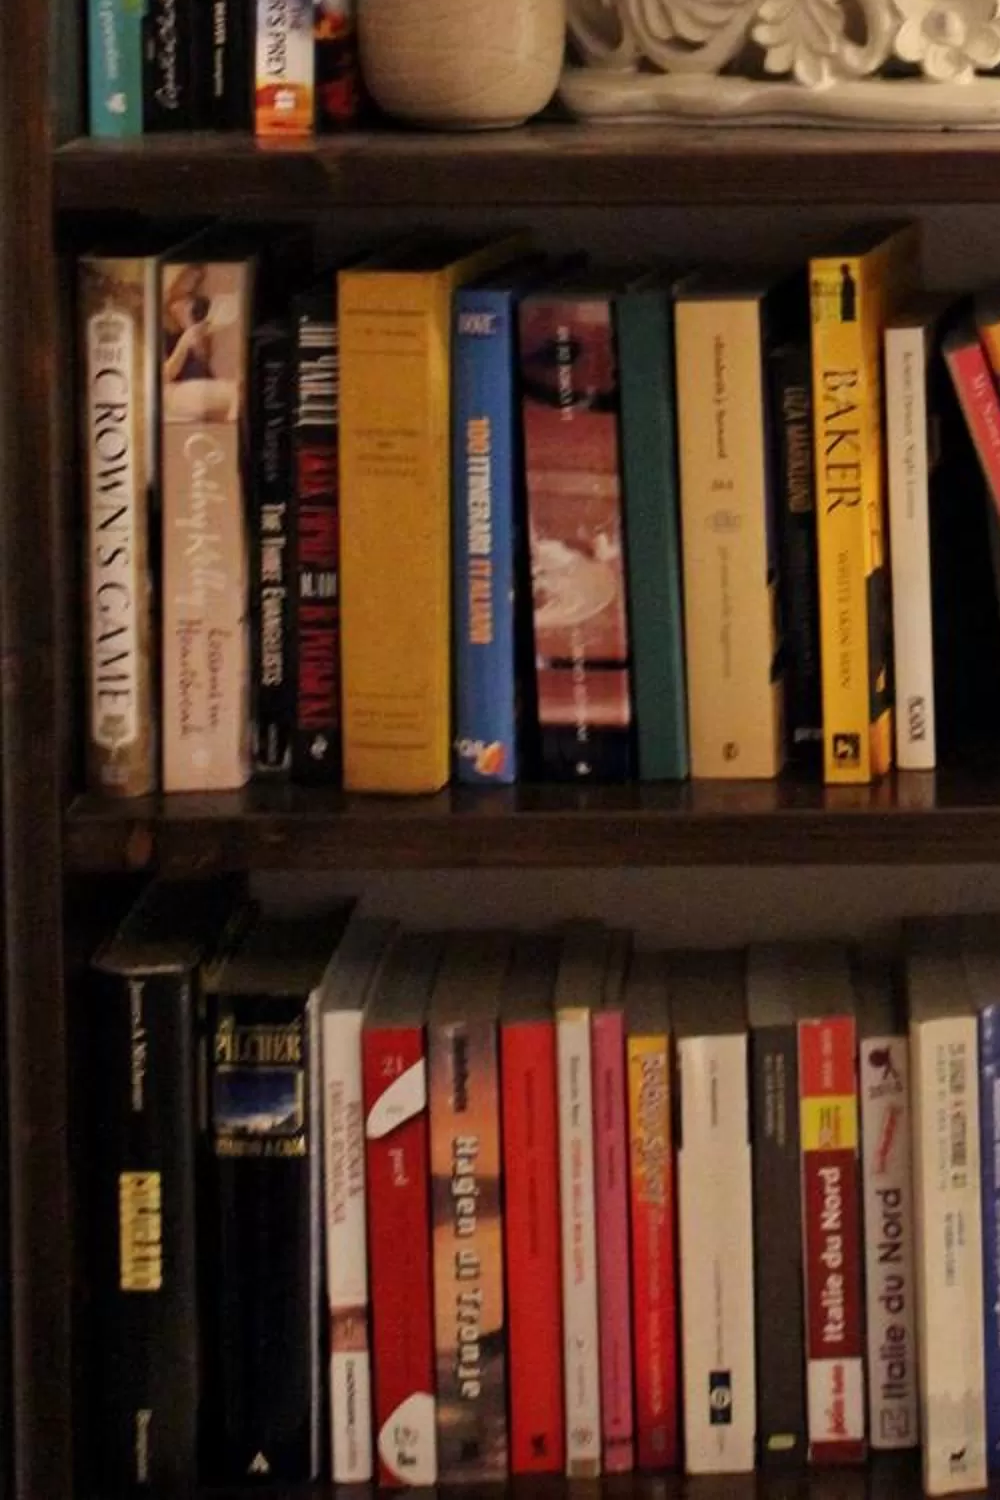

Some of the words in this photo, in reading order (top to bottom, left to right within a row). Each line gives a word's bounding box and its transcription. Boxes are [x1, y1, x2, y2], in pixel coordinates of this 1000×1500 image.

[266, 31, 289, 79] PREY
[92, 368, 131, 570] CROWN'S
[821, 368, 862, 517] BAKER
[93, 581, 132, 706] GAME
[449, 1136, 482, 1234] Hagen
[817, 1166, 842, 1229] Nord
[819, 1234, 843, 1268] du
[874, 1187, 902, 1262] Nord
[821, 1272, 845, 1342] Italie
[877, 1274, 905, 1313] du
[450, 1290, 483, 1400] Tronje
[880, 1326, 907, 1400] Italie
